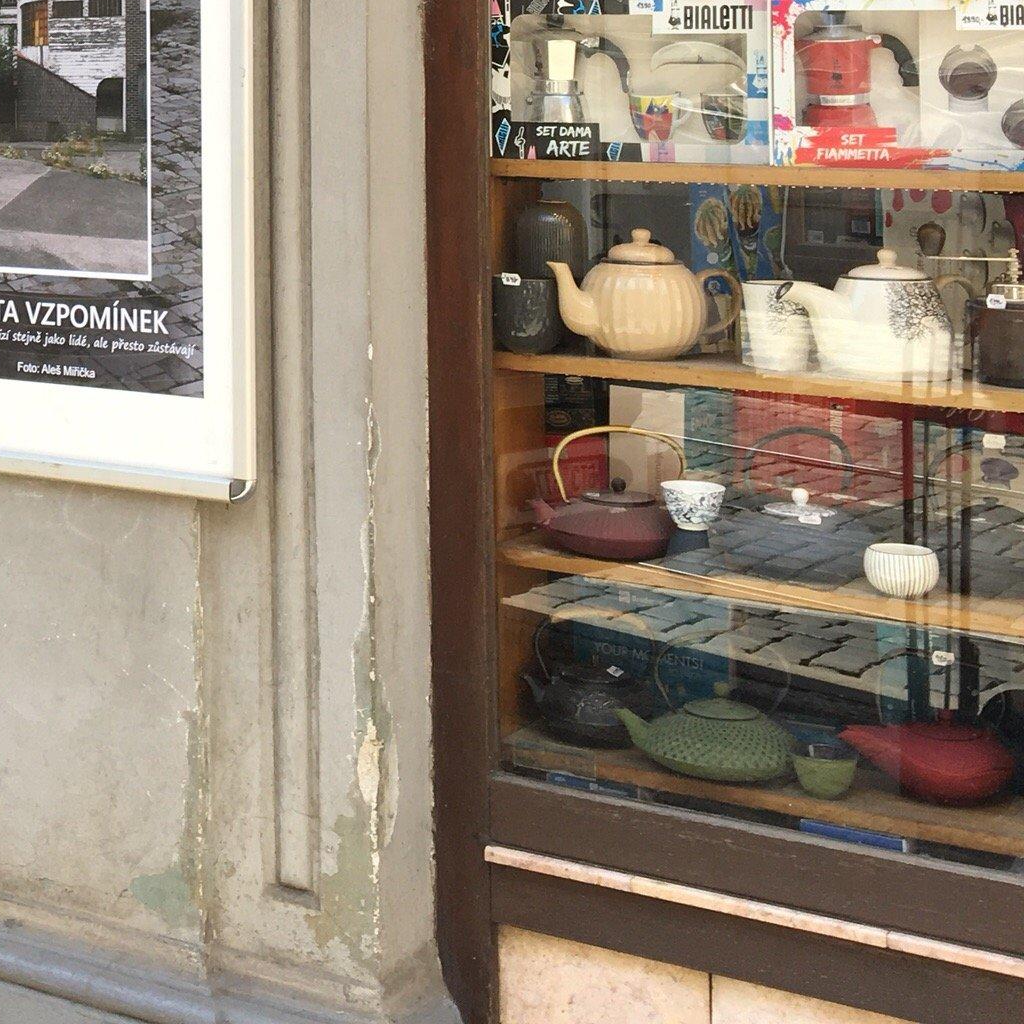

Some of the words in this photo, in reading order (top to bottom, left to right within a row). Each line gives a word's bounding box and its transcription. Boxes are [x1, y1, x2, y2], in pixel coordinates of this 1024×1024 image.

[683, 4, 754, 30] BIALETTI
[536, 126, 559, 138] SET
[559, 126, 592, 139] DAMA
[840, 133, 866, 146] SET
[546, 139, 592, 157] ARTE
[816, 147, 891, 162] FIAMMETTA
[26, 299, 170, 335] VZPOMÍNEK
[12, 330, 42, 346] stejně
[43, 332, 66, 347] jako
[68, 333, 92, 349] lidé,
[93, 337, 109, 349] ale
[111, 338, 145, 353] přesto
[148, 340, 197, 357] zůstávají
[17, 361, 40, 374] Foto:
[41, 363, 62, 376] Aleš
